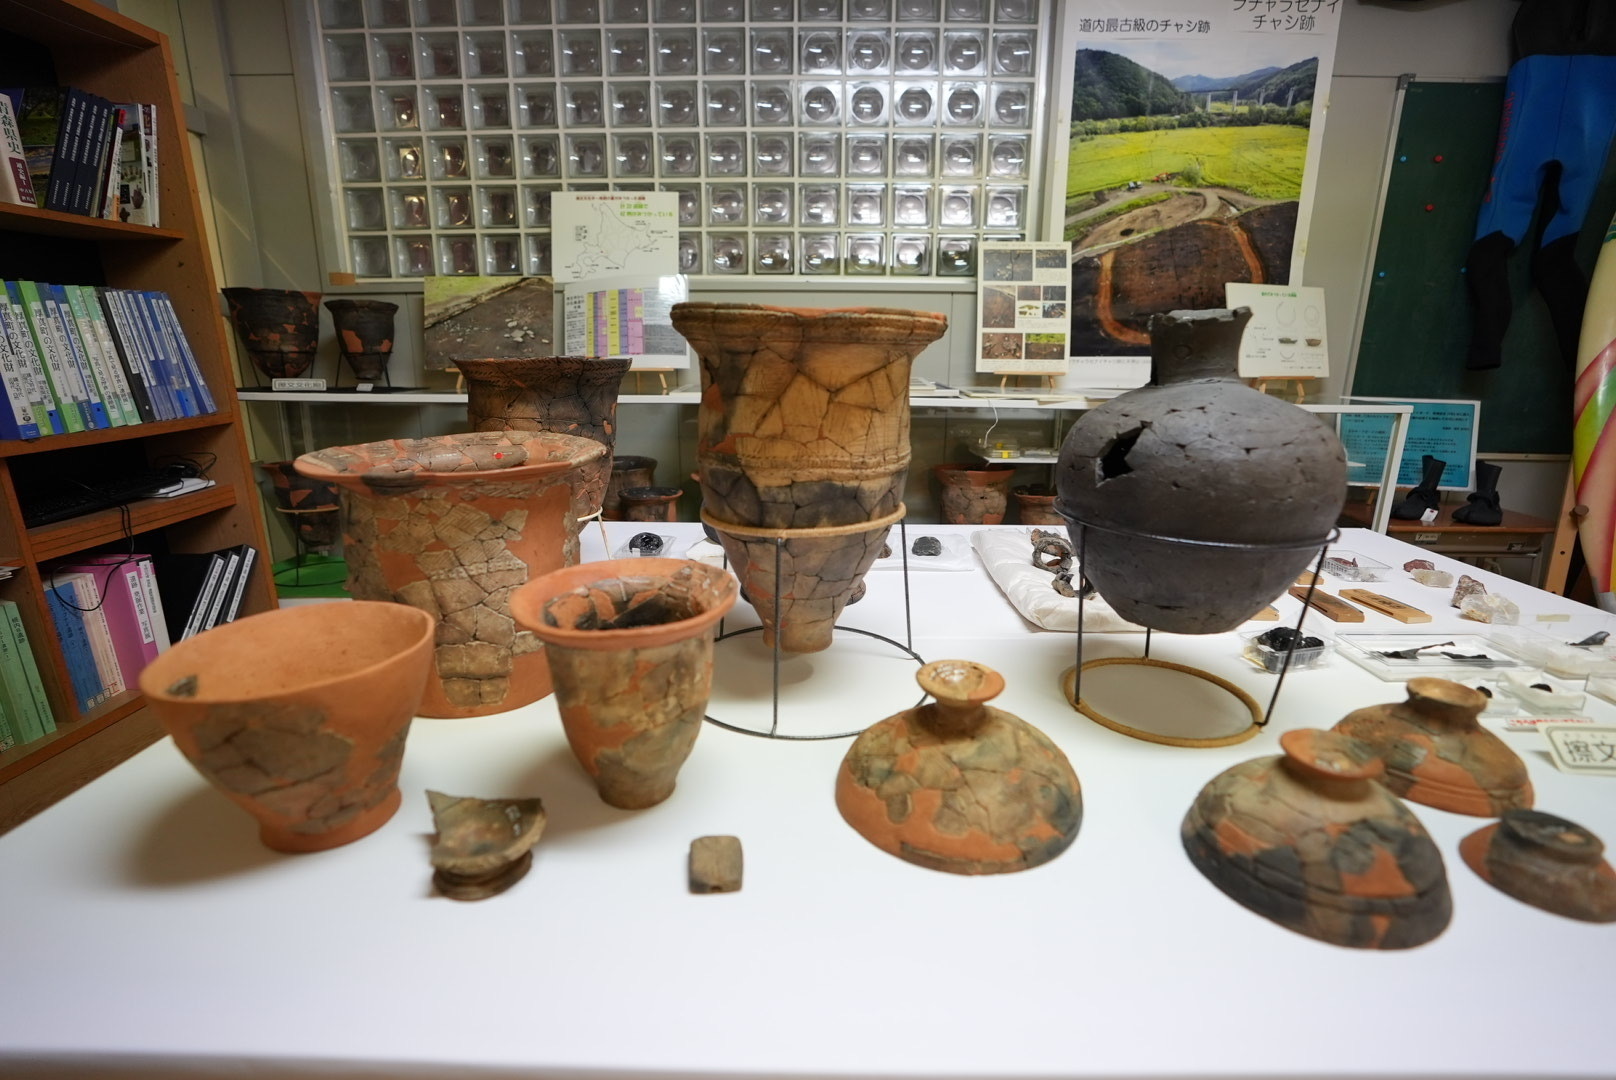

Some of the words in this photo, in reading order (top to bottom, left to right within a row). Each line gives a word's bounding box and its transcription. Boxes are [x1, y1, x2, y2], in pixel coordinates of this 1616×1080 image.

[1079, 18, 1211, 34] 道内最古級のチャシ跡
[1253, 14, 1316, 32] チャシ跡
[0, 303, 27, 368] 厚真町の文化財
[14, 311, 42, 376] 厚真町の文化財
[35, 308, 60, 372] 厚真町の文化財
[49, 307, 75, 369] 厚真町の文化財
